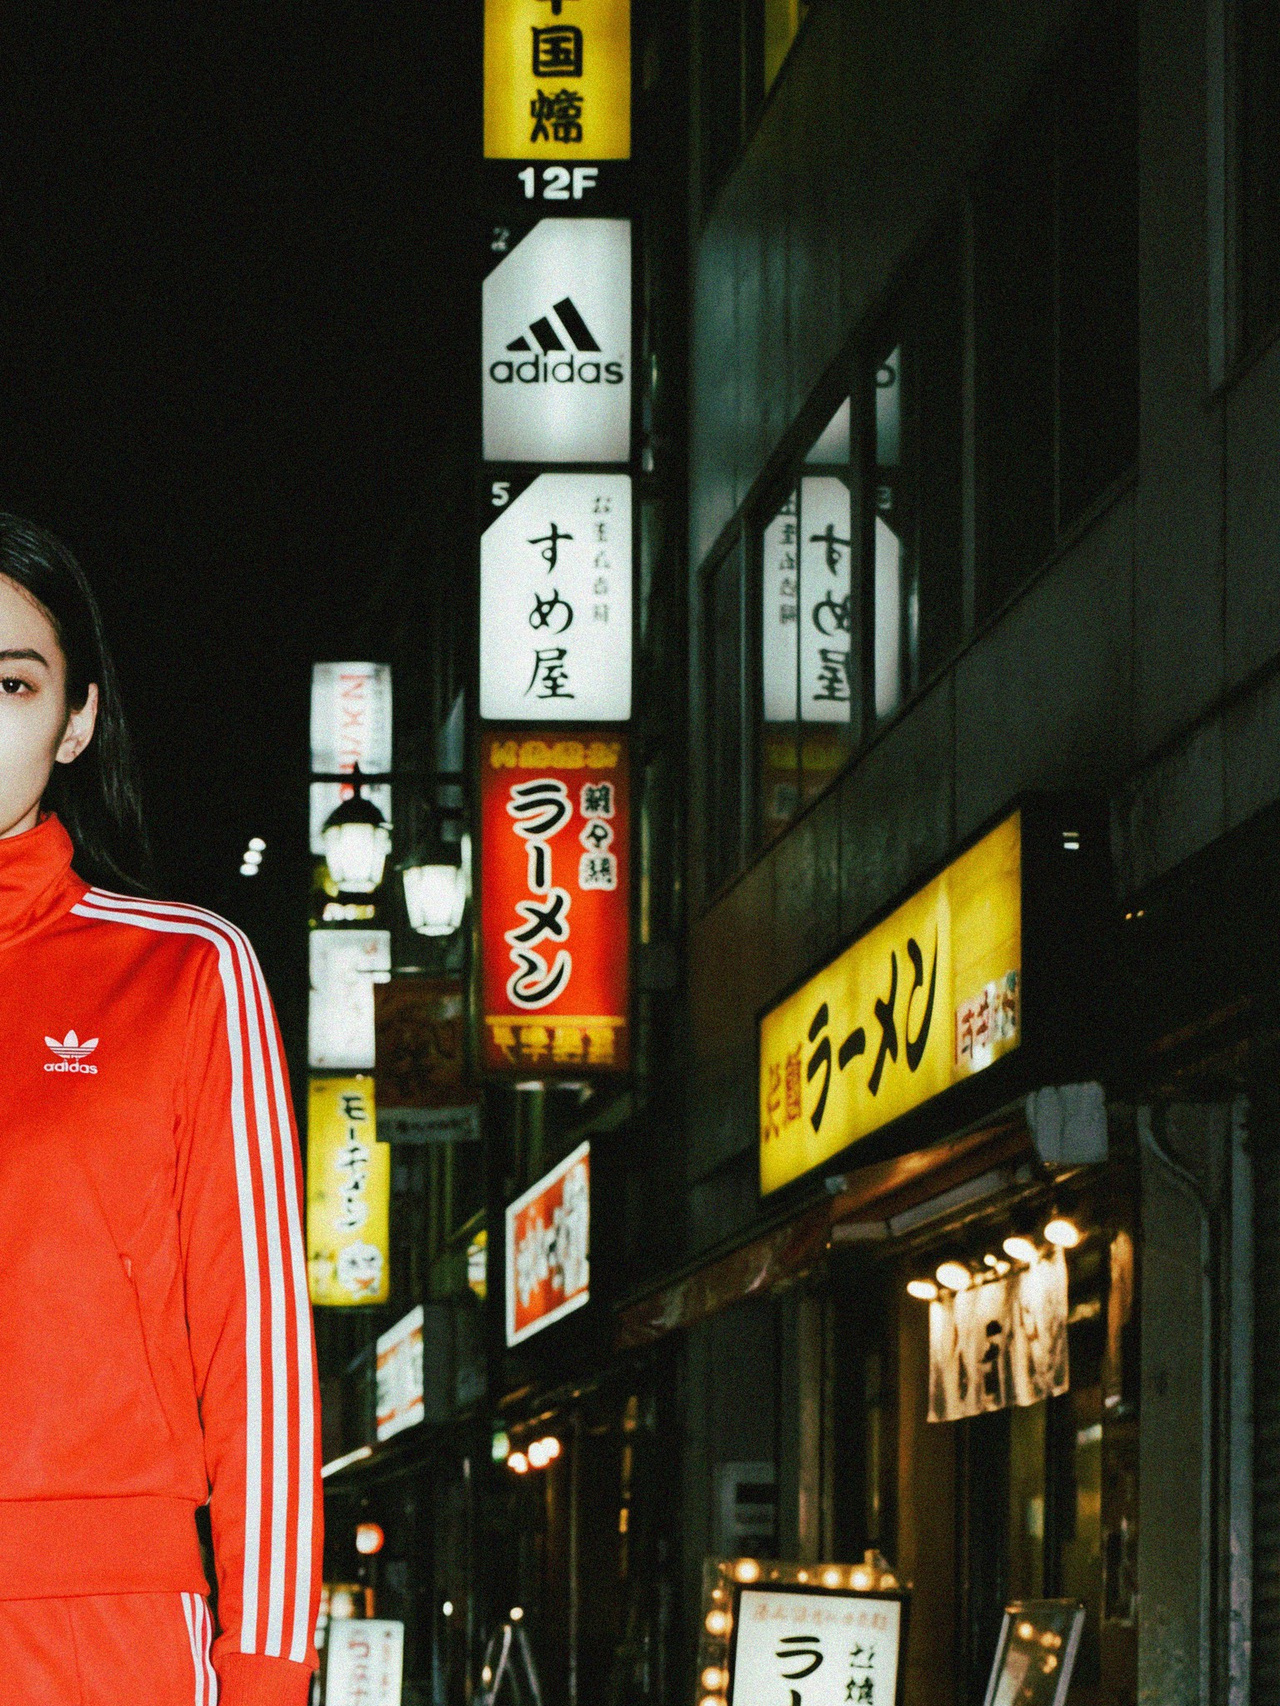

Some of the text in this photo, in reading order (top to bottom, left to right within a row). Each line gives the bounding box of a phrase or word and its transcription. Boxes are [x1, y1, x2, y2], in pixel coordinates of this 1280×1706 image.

[518, 166, 599, 200] 12F
[489, 353, 624, 384] adidas
[492, 481, 510, 506] 5
[524, 522, 575, 699] すめ屋
[508, 781, 570, 1006] ラーメン
[805, 918, 940, 1134] ラーメン
[43, 1058, 98, 1075] adidas
